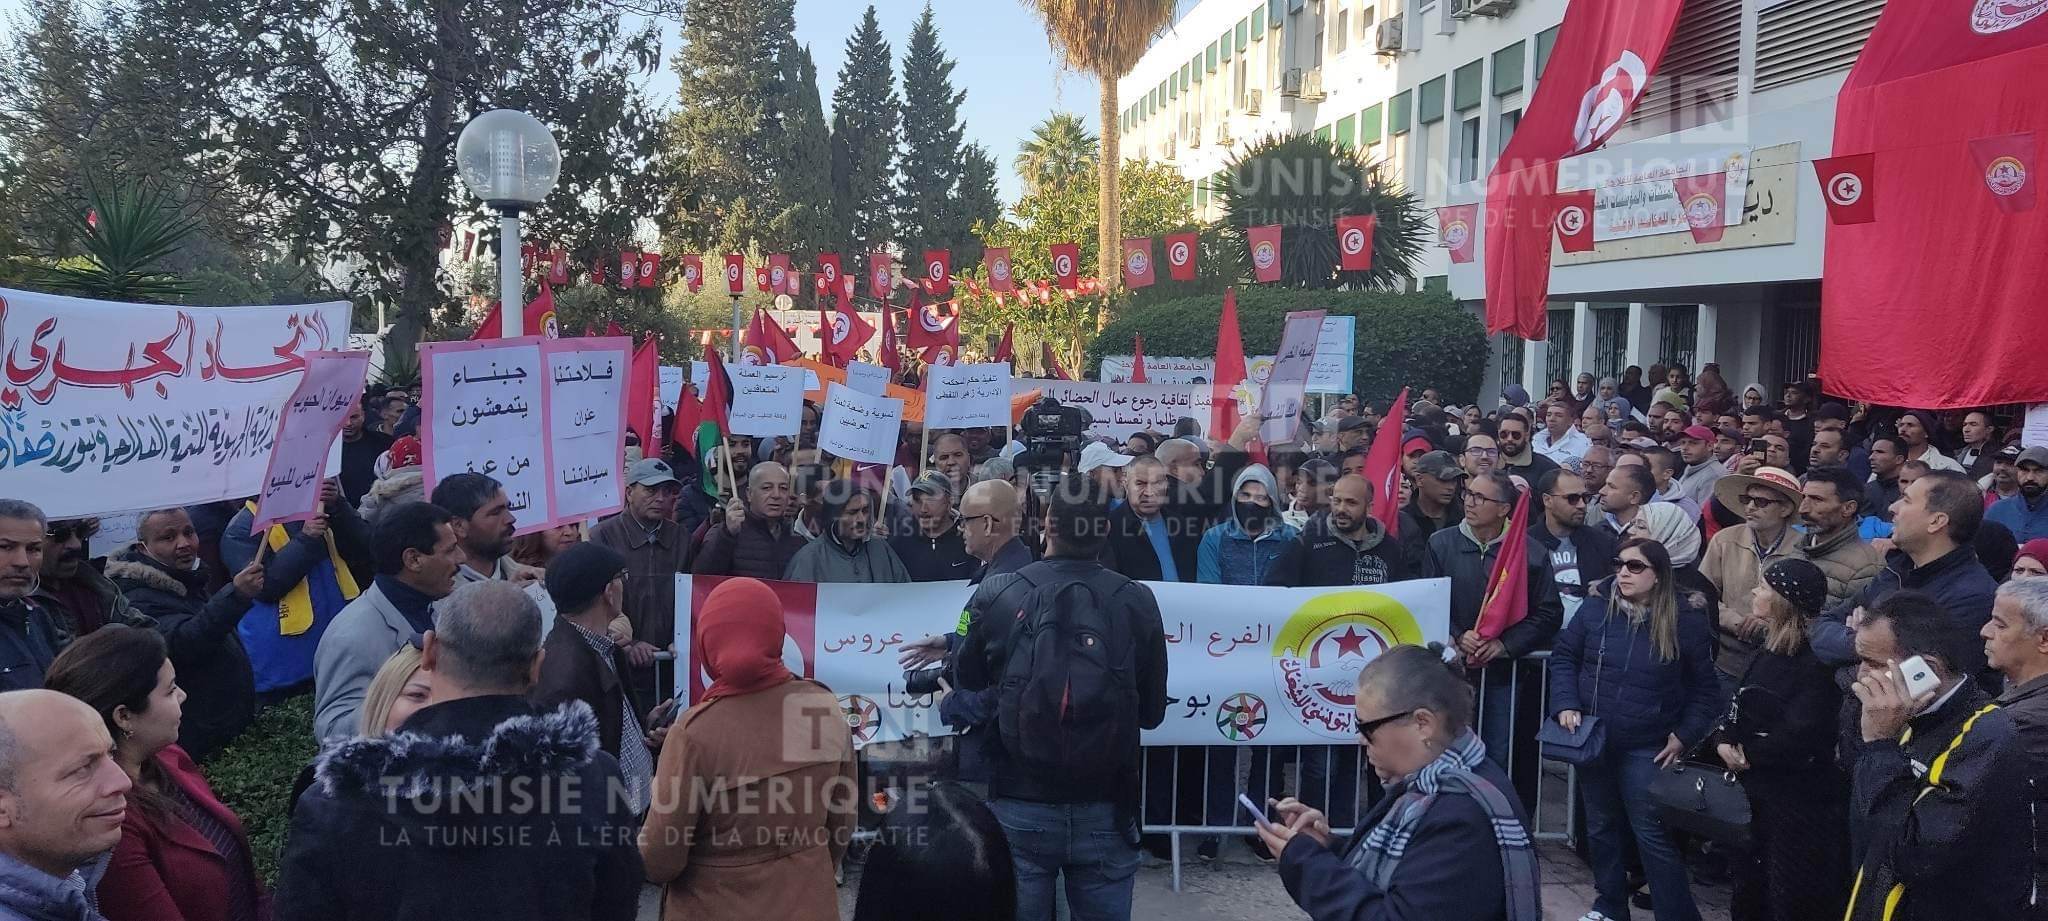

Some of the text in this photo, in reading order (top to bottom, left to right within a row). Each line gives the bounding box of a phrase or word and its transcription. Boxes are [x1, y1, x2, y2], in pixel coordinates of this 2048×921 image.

[452, 361, 528, 387] جبناء
[554, 359, 613, 386] فلاحتنا
[451, 395, 528, 427] يتمعشون
[1101, 390, 1128, 410] عمال
[1131, 395, 1158, 412] رجوع
[1114, 411, 1144, 426] تعسفا
[1146, 418, 1152, 429] و
[506, 454, 530, 476] من
[562, 462, 608, 486] سيادتنا
[824, 630, 905, 654] عروس
[1207, 622, 1272, 658] الفرع
